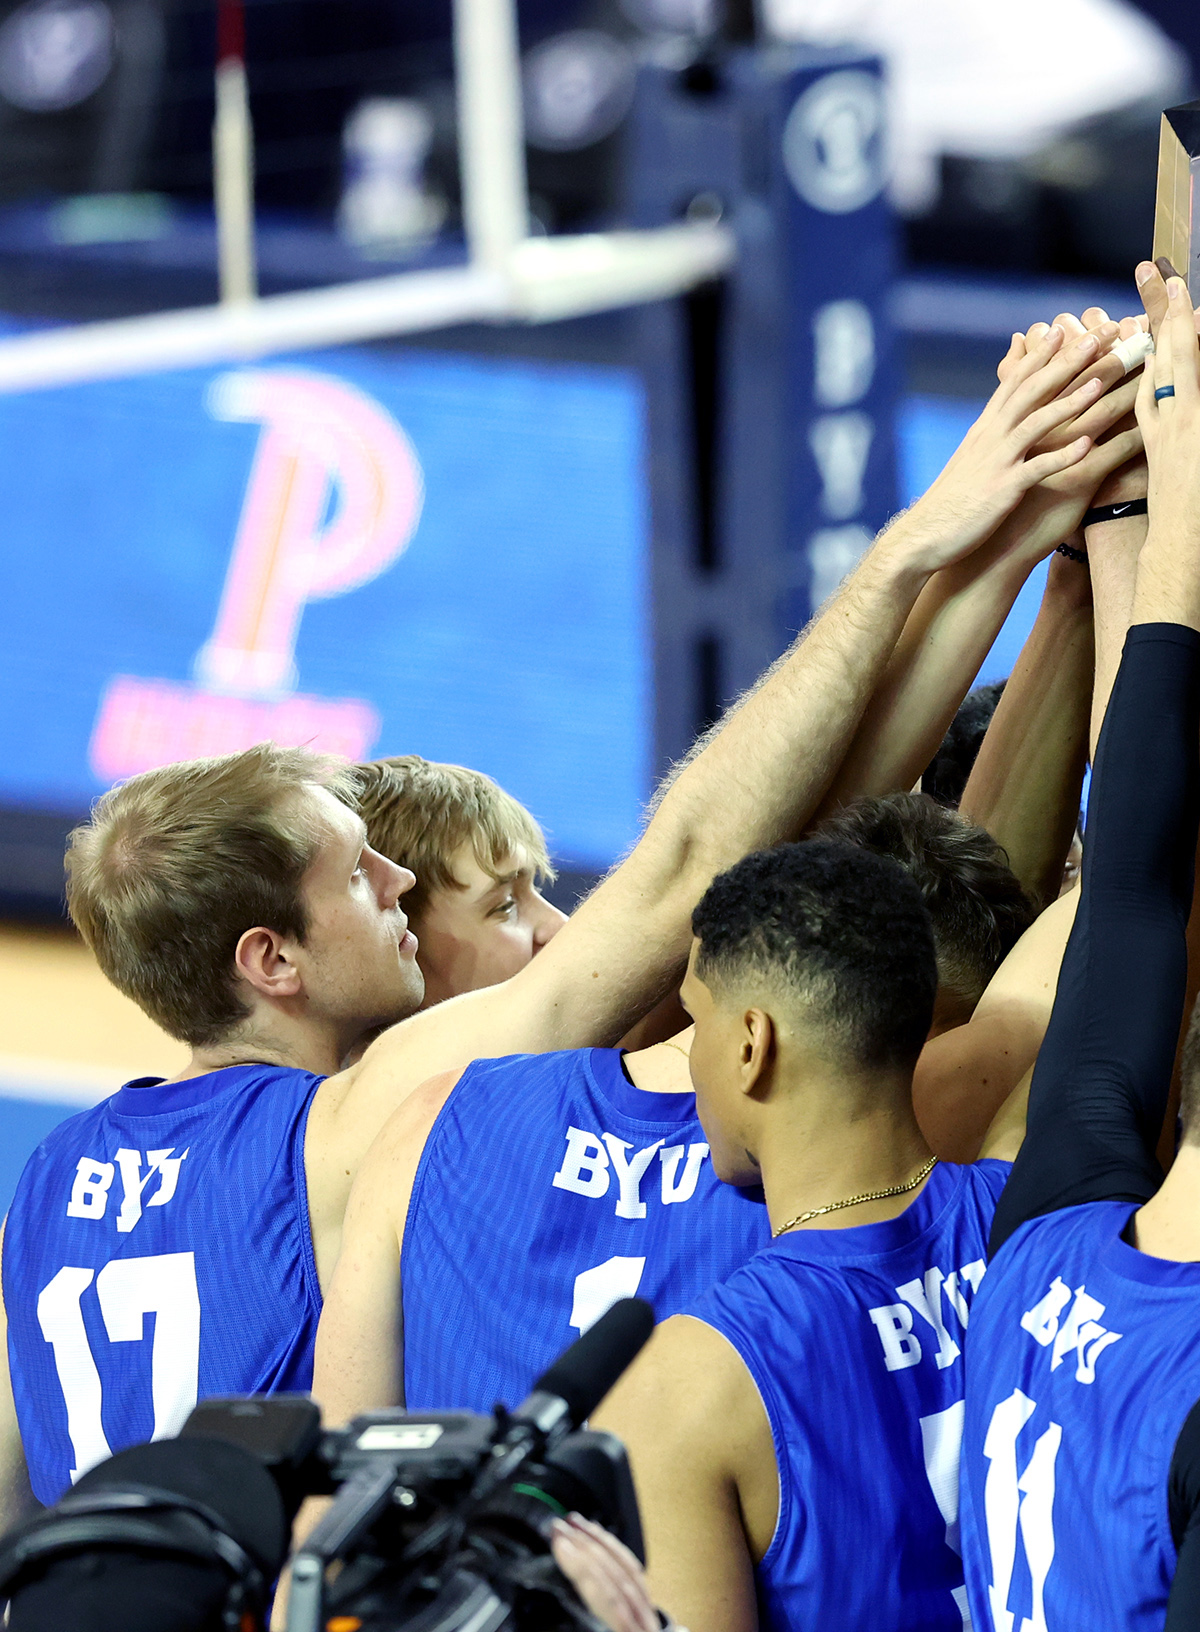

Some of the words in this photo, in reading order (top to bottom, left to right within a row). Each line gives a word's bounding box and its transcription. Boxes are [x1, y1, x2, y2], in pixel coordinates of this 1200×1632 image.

[66, 1147, 191, 1233] BYU
[552, 1126, 710, 1219] BYU
[37, 1251, 201, 1481] 17
[1020, 1276, 1123, 1384] BYU
